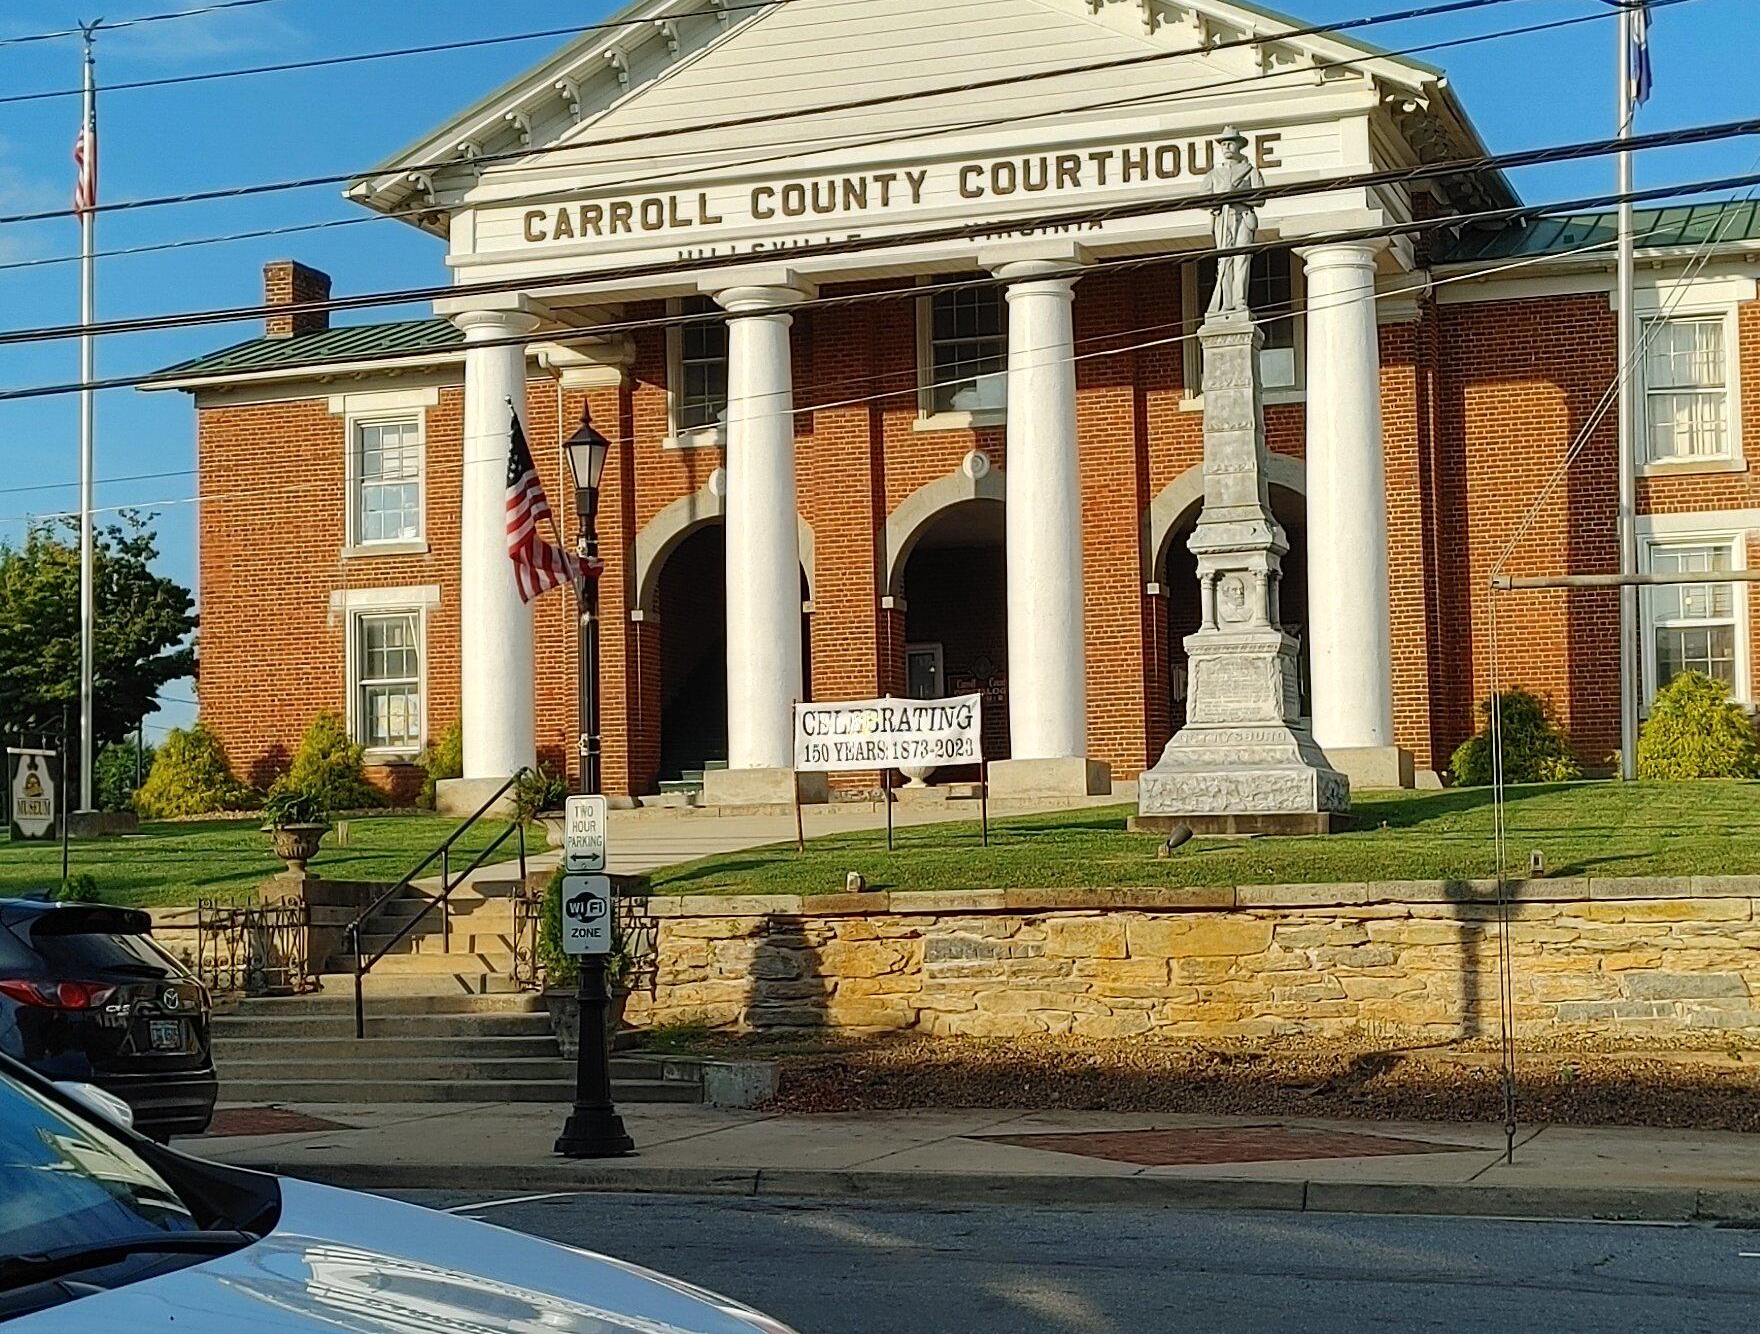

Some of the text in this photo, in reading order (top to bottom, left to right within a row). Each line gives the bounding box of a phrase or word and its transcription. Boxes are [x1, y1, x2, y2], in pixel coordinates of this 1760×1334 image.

[523, 132, 1283, 243] CARROLL COUNTY COURTHOUE
[802, 704, 974, 737] CELEBRATING
[804, 743, 829, 763] 150
[892, 737, 974, 760] 1873-2023
[574, 805, 594, 818] TWO
[572, 820, 596, 833] HOUR
[568, 835, 603, 848] PARKING
[571, 927, 602, 938] ZONE
